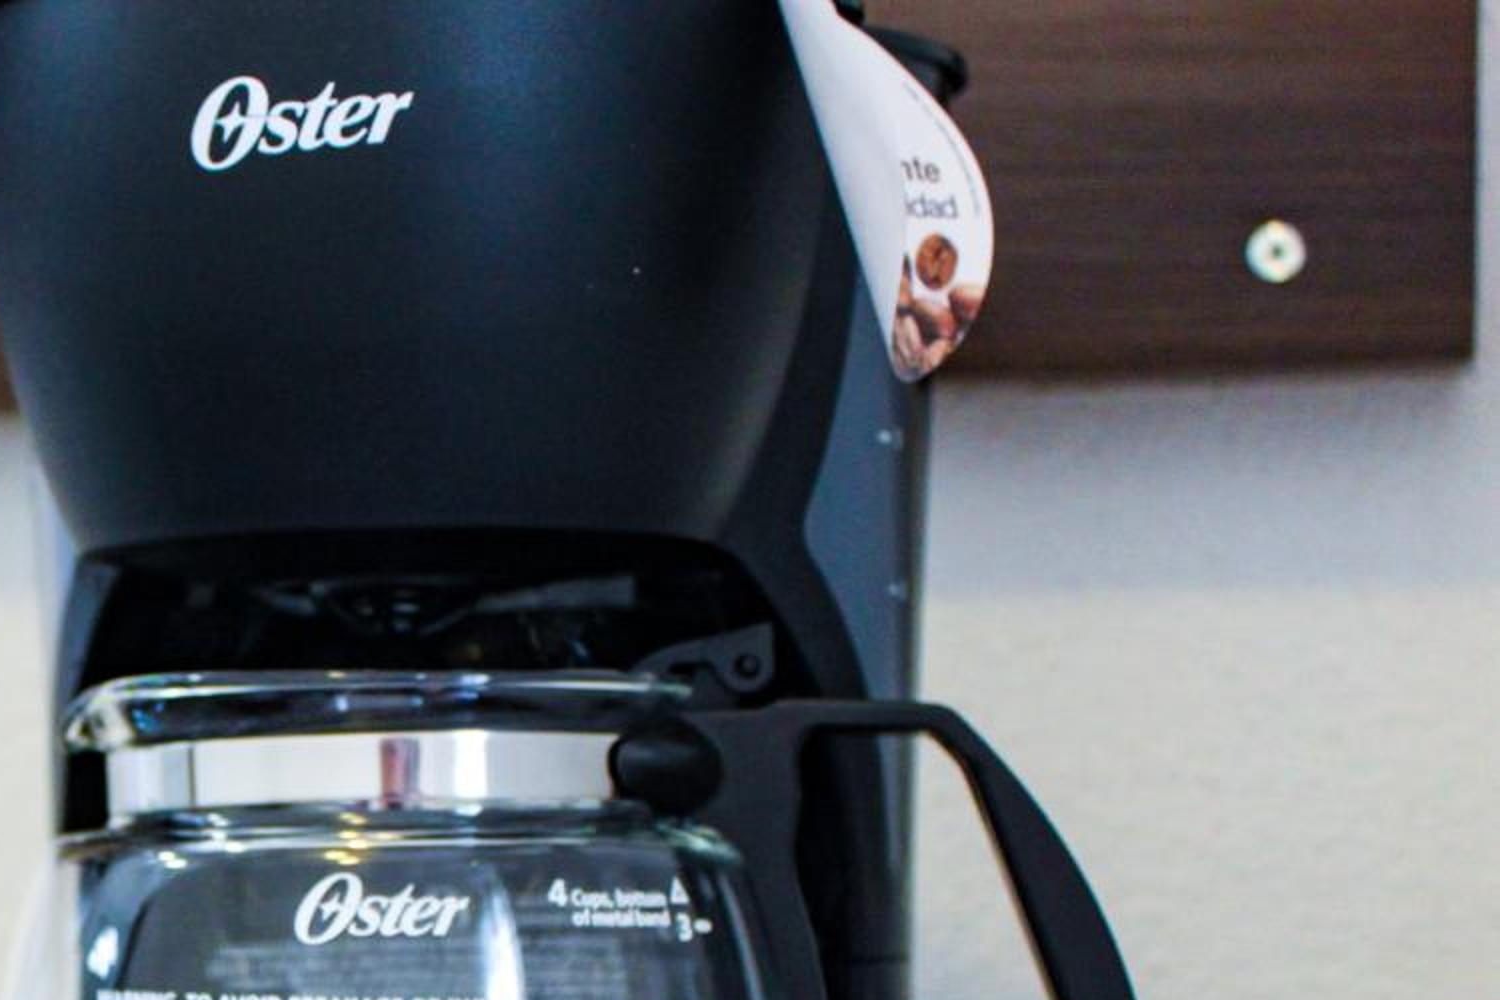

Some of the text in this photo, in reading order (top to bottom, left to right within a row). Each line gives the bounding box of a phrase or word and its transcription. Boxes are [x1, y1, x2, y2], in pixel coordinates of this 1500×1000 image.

[191, 75, 414, 171] Oster
[293, 871, 470, 945] Oster
[548, 878, 568, 907] 4
[676, 912, 693, 942] 3
